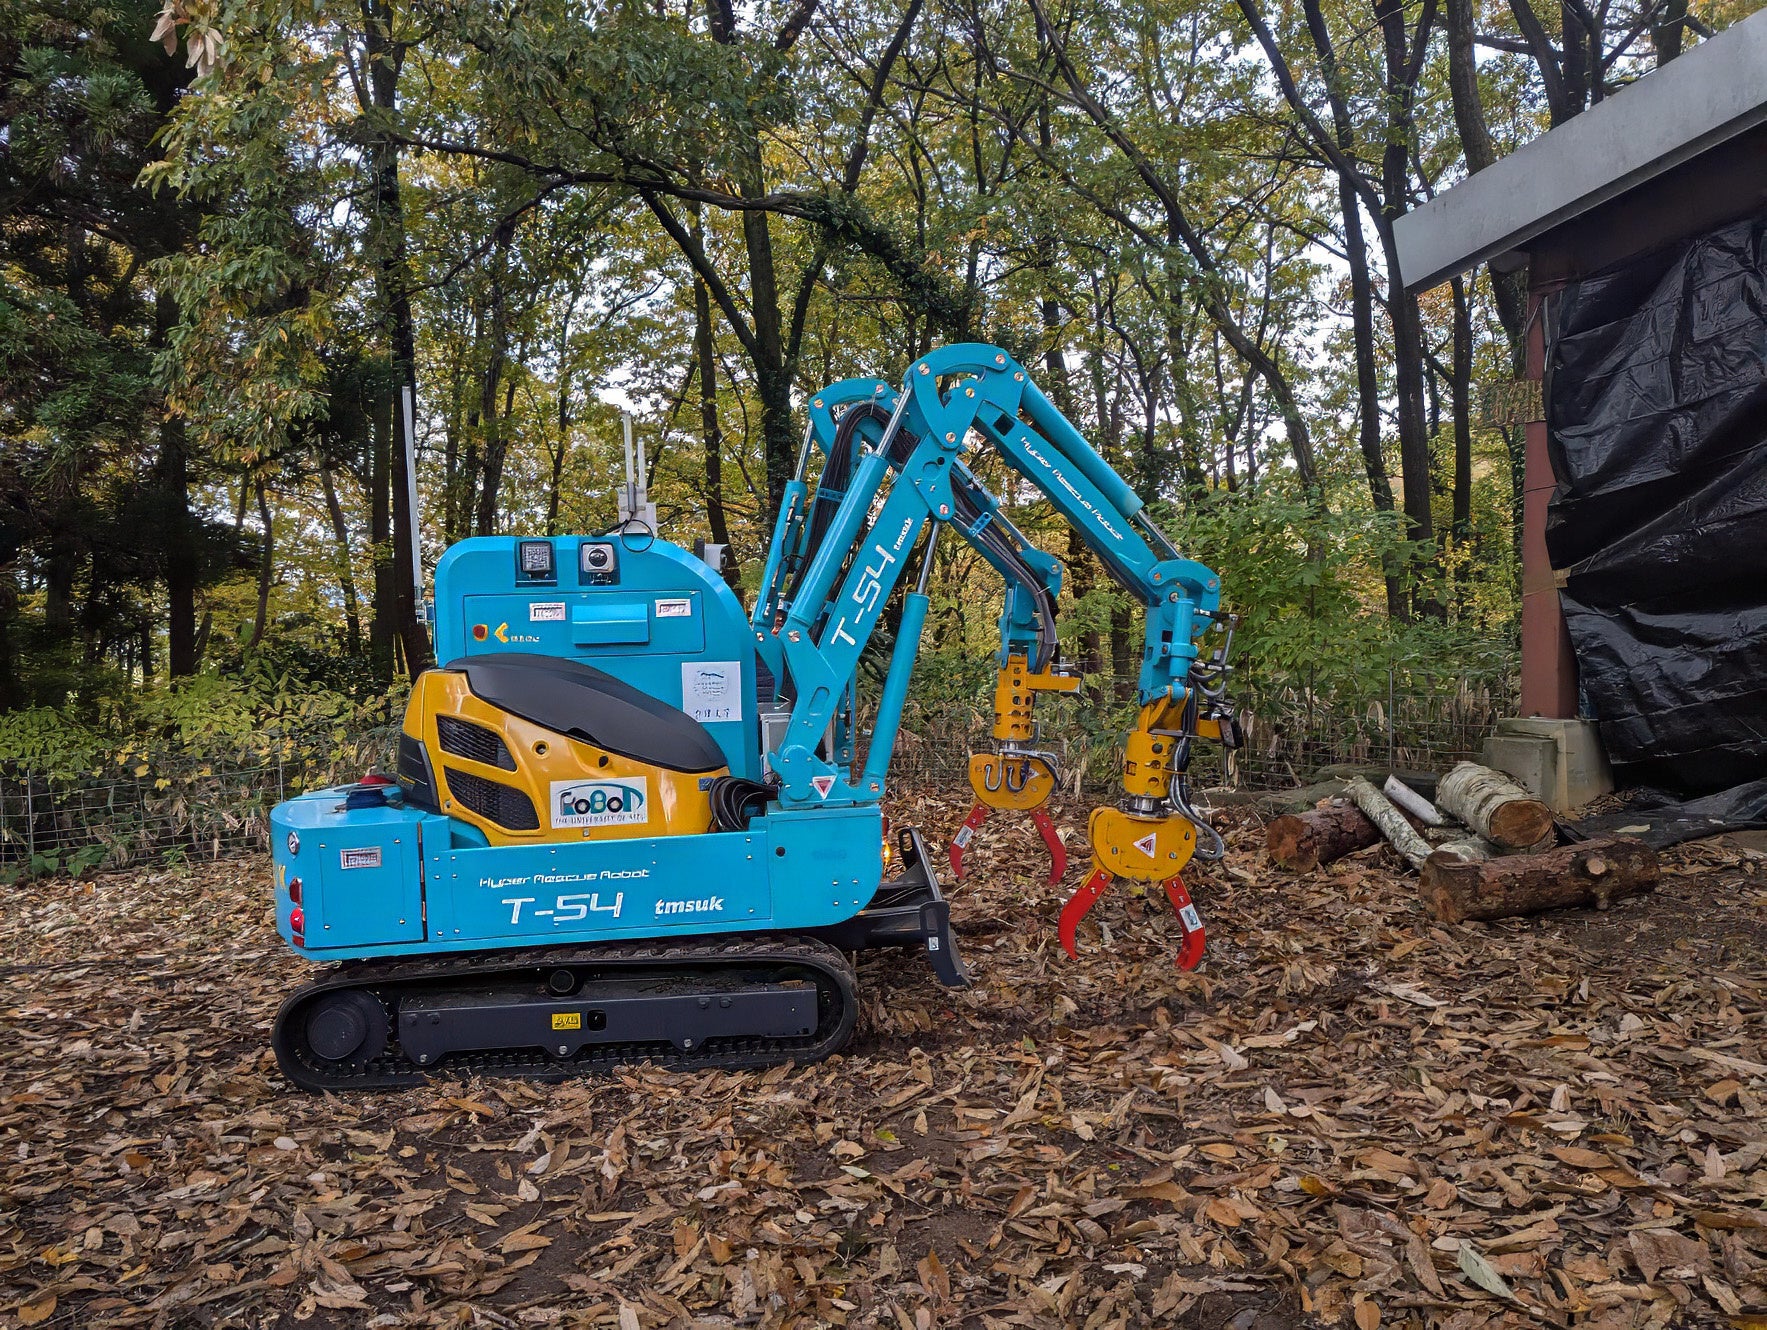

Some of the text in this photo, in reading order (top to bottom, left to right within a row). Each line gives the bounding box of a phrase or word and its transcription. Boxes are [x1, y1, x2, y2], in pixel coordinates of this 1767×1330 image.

[830, 544, 896, 646] T-54
[479, 869, 650, 889] Hyper Rescue Robot
[501, 892, 725, 925] T-54 tmsuk
